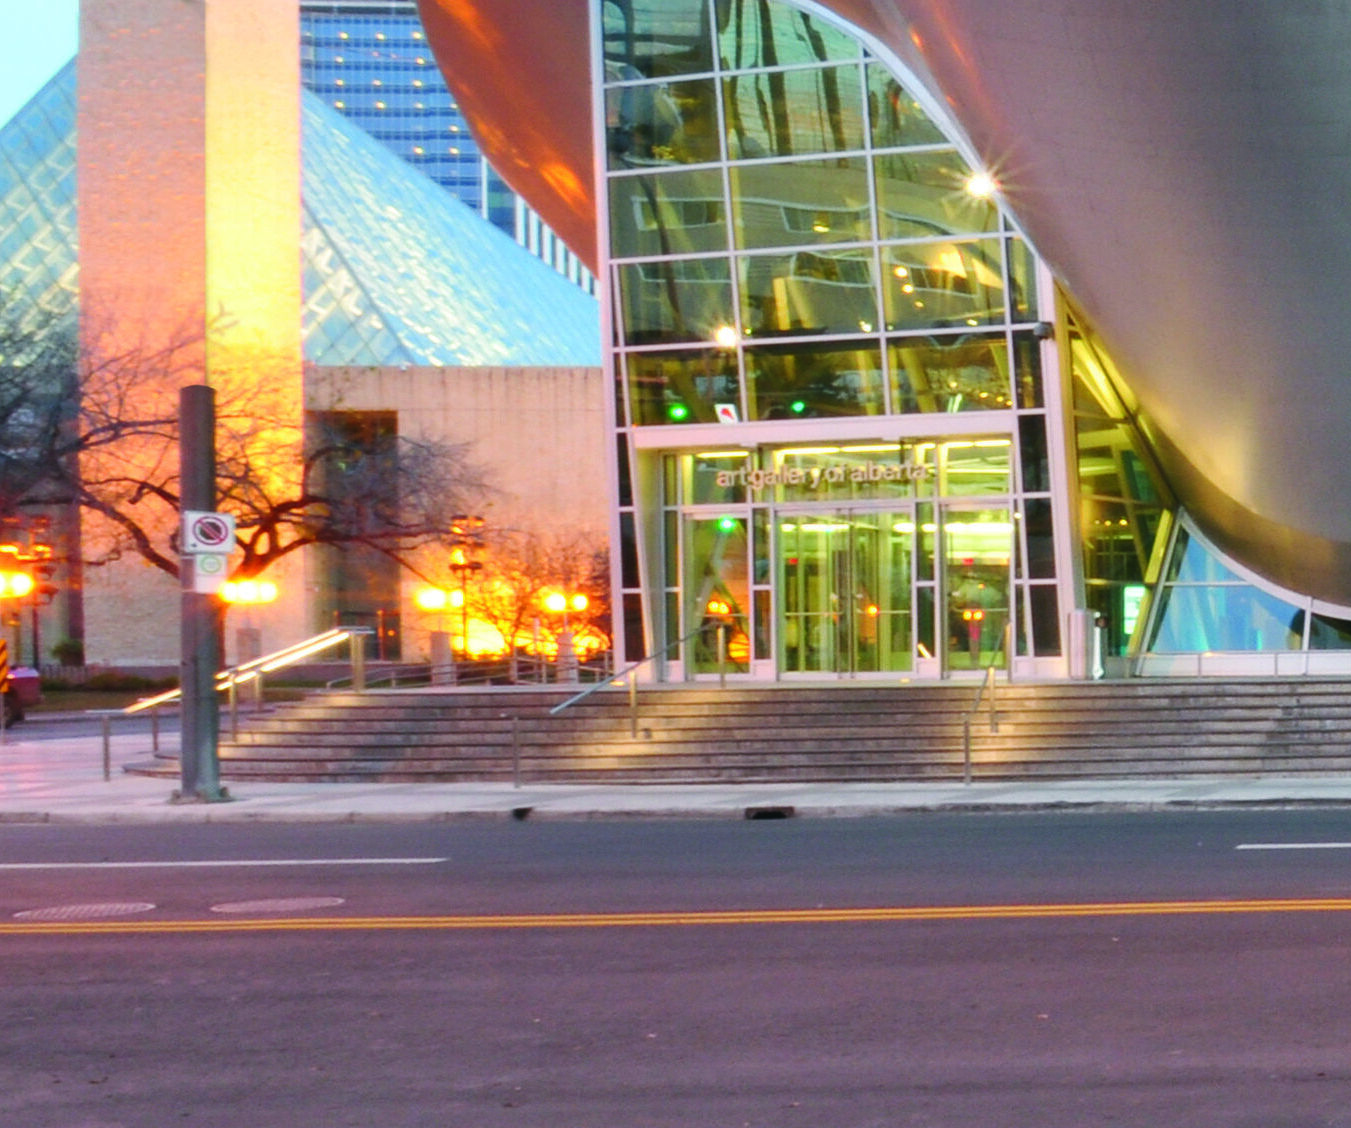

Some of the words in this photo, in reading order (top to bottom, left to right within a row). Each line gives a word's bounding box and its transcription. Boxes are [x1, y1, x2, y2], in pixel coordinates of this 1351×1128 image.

[716, 466, 748, 487] art
[749, 462, 820, 489] gallery
[825, 462, 846, 483] of
[850, 458, 926, 482] alberta
